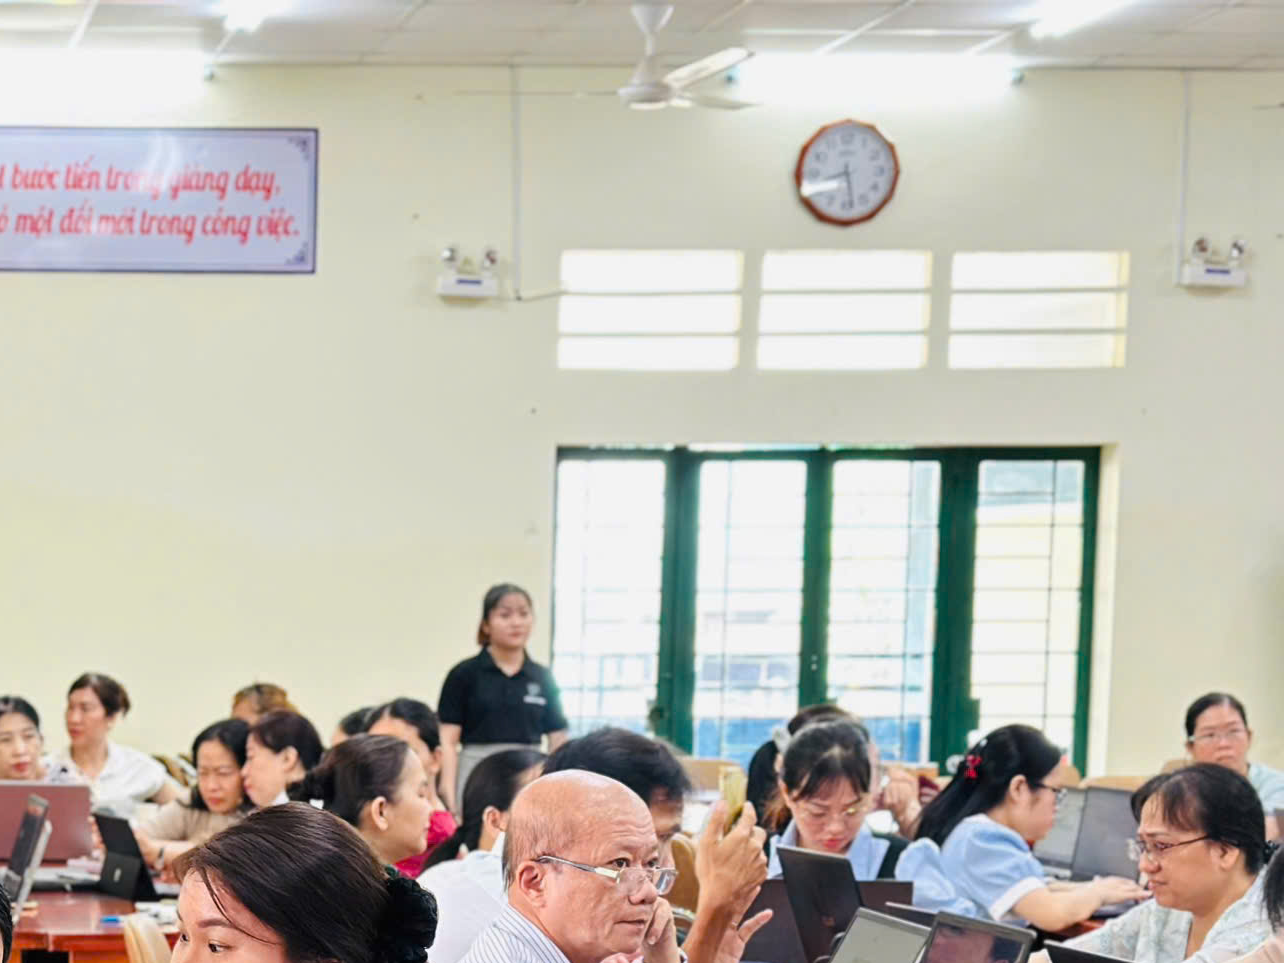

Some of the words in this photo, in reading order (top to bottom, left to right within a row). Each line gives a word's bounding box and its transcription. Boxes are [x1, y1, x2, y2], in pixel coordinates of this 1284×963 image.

[12, 162, 59, 191] bước
[64, 154, 101, 191] tiến
[15, 205, 54, 238] một
[139, 207, 197, 246] trong
[201, 206, 252, 246] công
[255, 206, 300, 243] việc.
